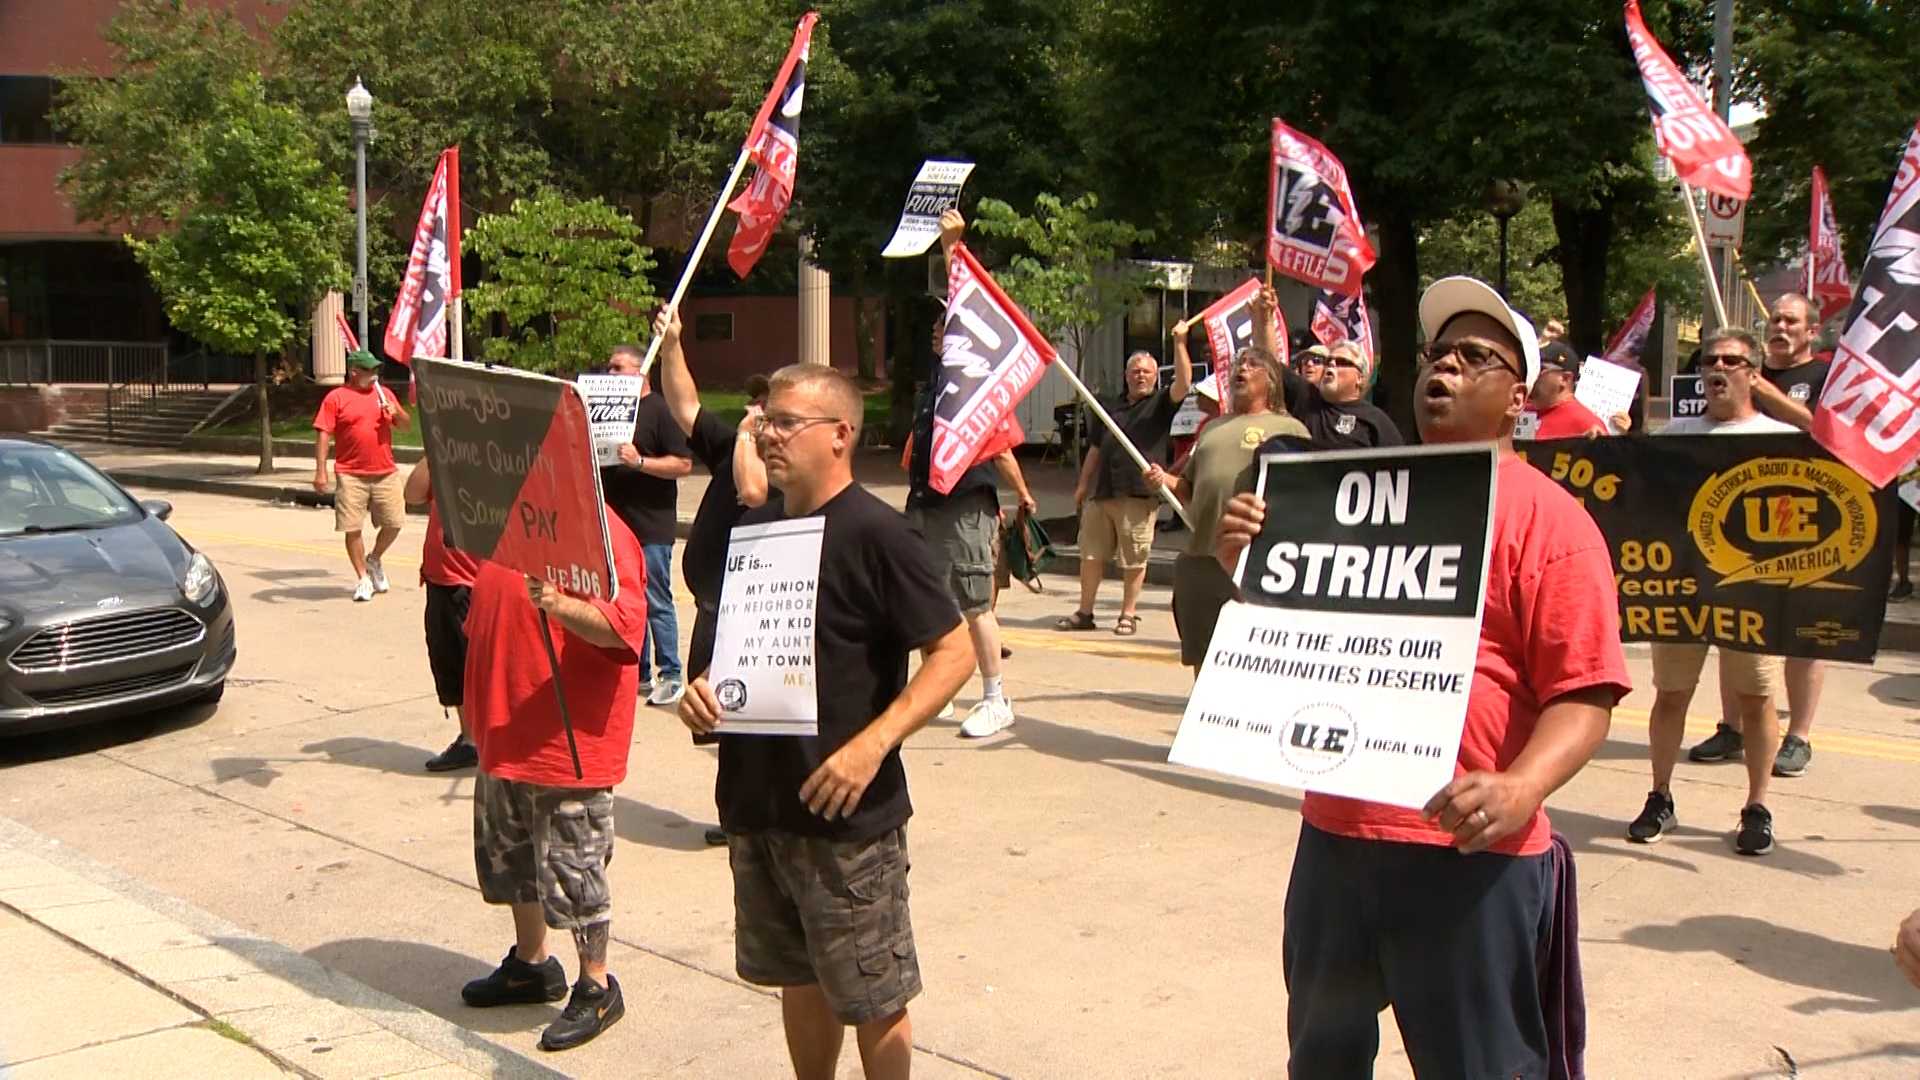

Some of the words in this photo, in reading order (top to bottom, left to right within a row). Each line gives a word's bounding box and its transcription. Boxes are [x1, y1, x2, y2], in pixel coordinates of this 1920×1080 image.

[420, 368, 471, 414] Same
[1694, 380, 1705, 394] O
[430, 426, 482, 468] Same
[1551, 452, 1622, 501] 506
[1758, 463, 1788, 478] RADIO
[1792, 464, 1800, 477] &
[1805, 466, 1849, 500] MACHINE
[1335, 469, 1410, 526] ON
[1707, 467, 1753, 509] ELECTRICAL
[520, 501, 558, 543] PAY
[1699, 511, 1716, 550] UNITED
[1743, 495, 1819, 542] UE
[1845, 497, 1866, 548] WORKERS
[728, 556, 746, 572] UE
[1260, 541, 1463, 601] STRIKE
[1620, 540, 1672, 573] 80
[1754, 564, 1771, 575] OF
[1776, 547, 1841, 573] AMERICA
[746, 584, 764, 596] MY
[770, 580, 815, 594] UNION
[720, 603, 738, 616] MY
[744, 598, 814, 613] NEIGHBOR
[760, 618, 780, 630] MY
[788, 617, 812, 629] KID
[744, 636, 765, 648] MY
[772, 635, 812, 648] AUNT
[1618, 604, 1766, 646] REVER
[1248, 626, 1290, 648] FOR
[1295, 632, 1334, 652] THE
[1338, 635, 1392, 659] JOBS
[1399, 638, 1443, 661] OUR
[738, 655, 759, 667] MY
[767, 655, 812, 667] TOWN
[1214, 650, 1361, 685] COMMUNITIES
[1366, 666, 1465, 694] DESERVE
[1199, 712, 1241, 729] LOCAL
[1364, 737, 1409, 754] LOCAL
[1413, 745, 1443, 759] 618
